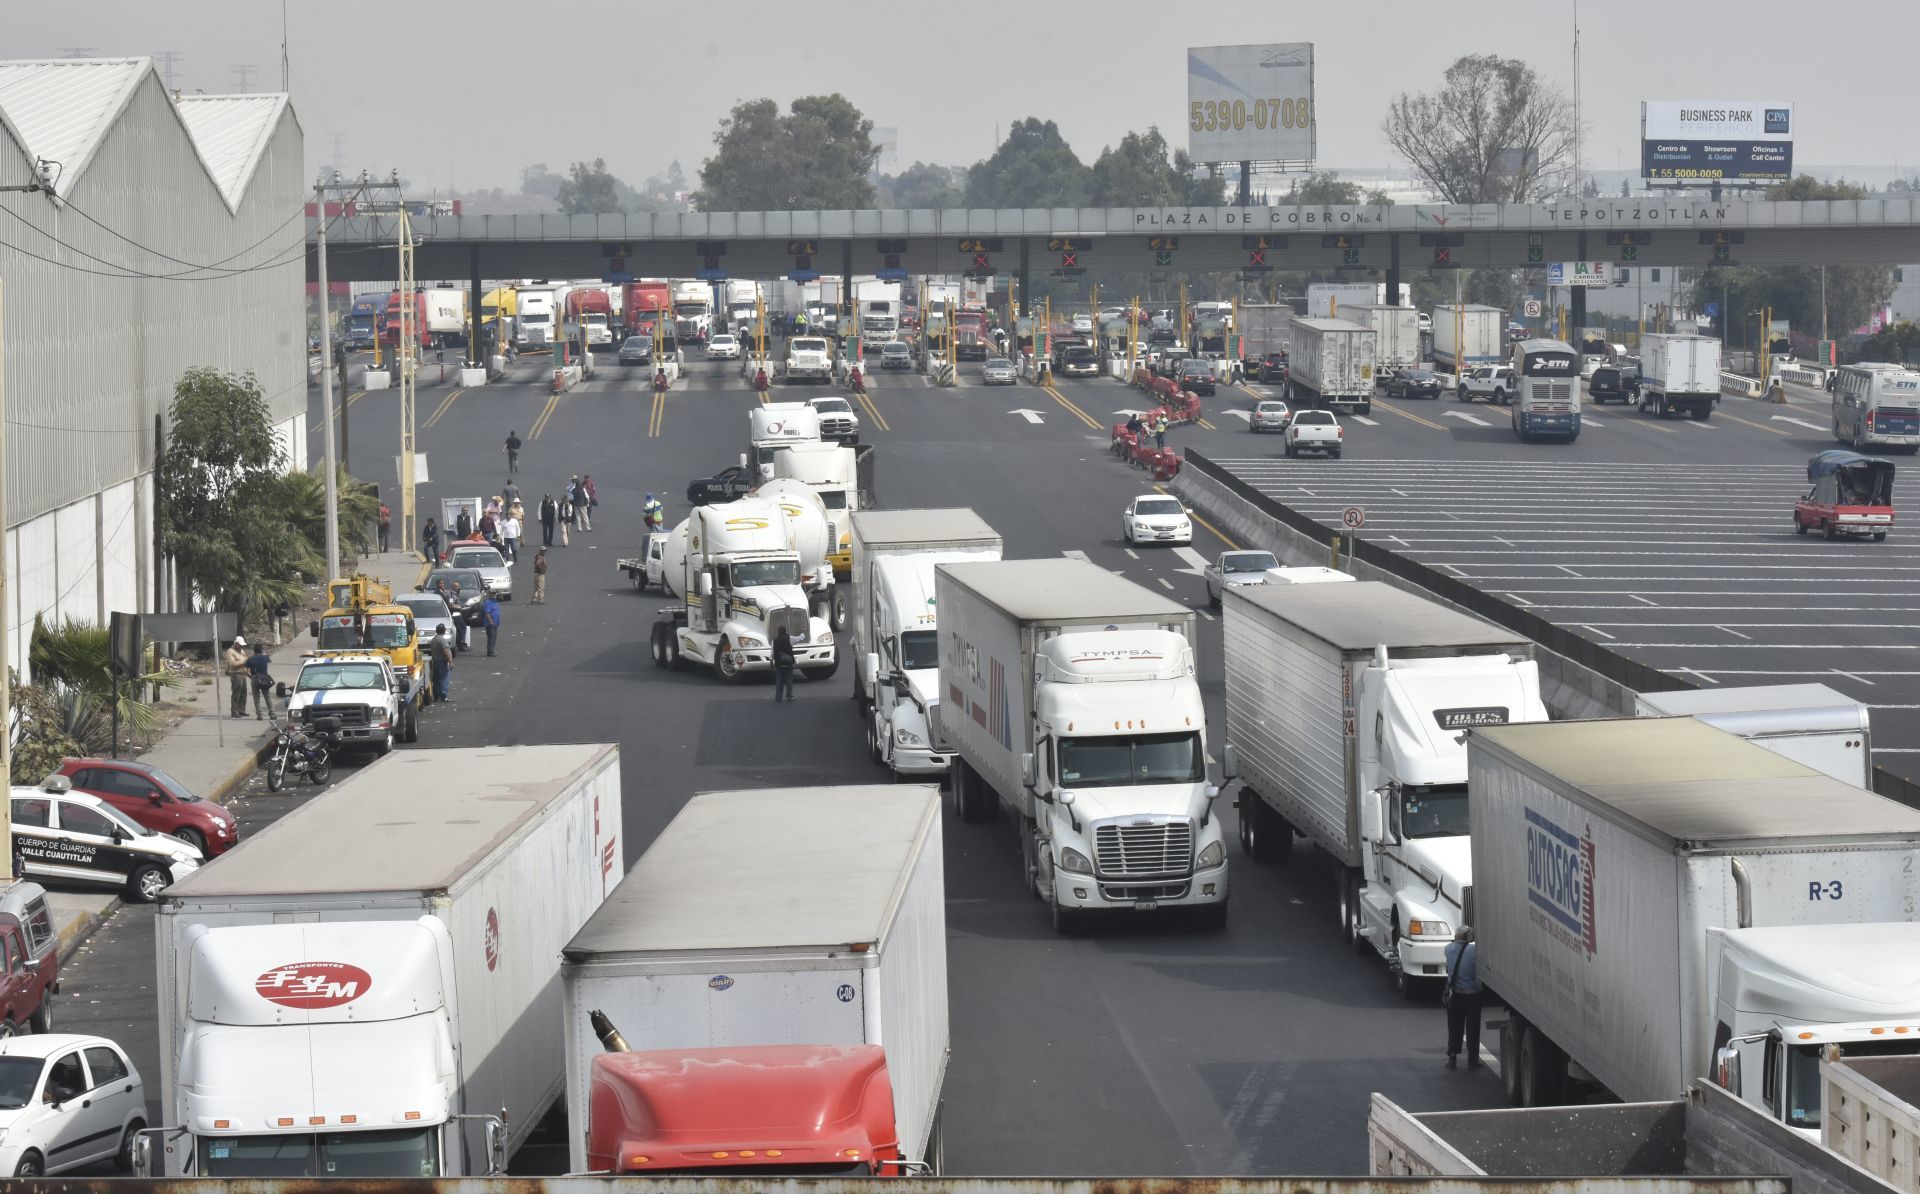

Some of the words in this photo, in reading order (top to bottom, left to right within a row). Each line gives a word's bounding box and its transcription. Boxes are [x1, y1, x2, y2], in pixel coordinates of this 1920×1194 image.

[1191, 97, 1309, 132] 5390-0708
[1680, 109, 1726, 121] BUSINESS
[1728, 109, 1753, 121] PARK
[1766, 111, 1787, 122] CPA
[1703, 145, 1737, 153] Showroom
[1650, 168, 1658, 177] T.
[1661, 168, 1673, 177] 55
[1674, 169, 1723, 178] 5000-0050
[1137, 213, 1208, 226] PLAZA
[1227, 213, 1253, 225] DE
[1271, 212, 1351, 224] COBRO
[1356, 213, 1373, 224] No.
[1375, 212, 1382, 223] 4
[1547, 359, 1570, 369] ETN
[1896, 381, 1918, 389] ETN
[1080, 649, 1153, 658] TYMPSA
[1344, 719, 1355, 736] 24
[17, 837, 48, 848] CUERPO
[48, 841, 59, 850] DE
[59, 843, 97, 855] GUARDIAS
[21, 846, 45, 857] VALLE
[1527, 826, 1582, 918] AUTOSAG
[1809, 880, 1843, 901] R-3
[283, 962, 345, 971] TRANSPORTES
[709, 977, 735, 988] UTILITY
[838, 986, 853, 1000] C-08
